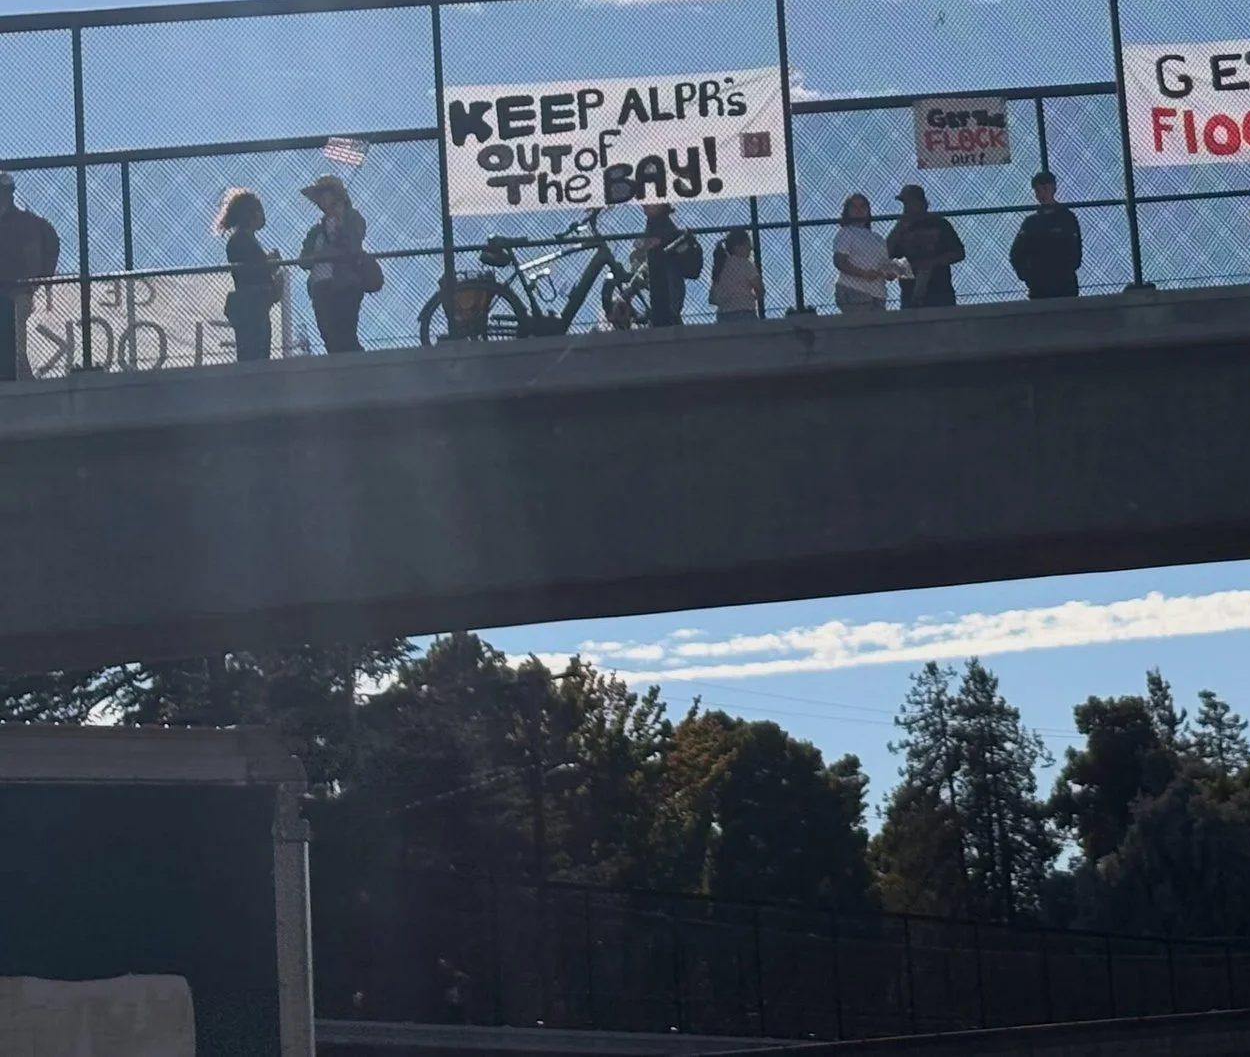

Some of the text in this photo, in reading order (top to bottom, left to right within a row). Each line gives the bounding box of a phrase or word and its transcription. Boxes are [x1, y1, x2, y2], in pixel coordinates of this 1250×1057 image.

[449, 89, 604, 147] KEEP
[923, 128, 1007, 152] FLOCK
[486, 136, 724, 205] The BAY!
